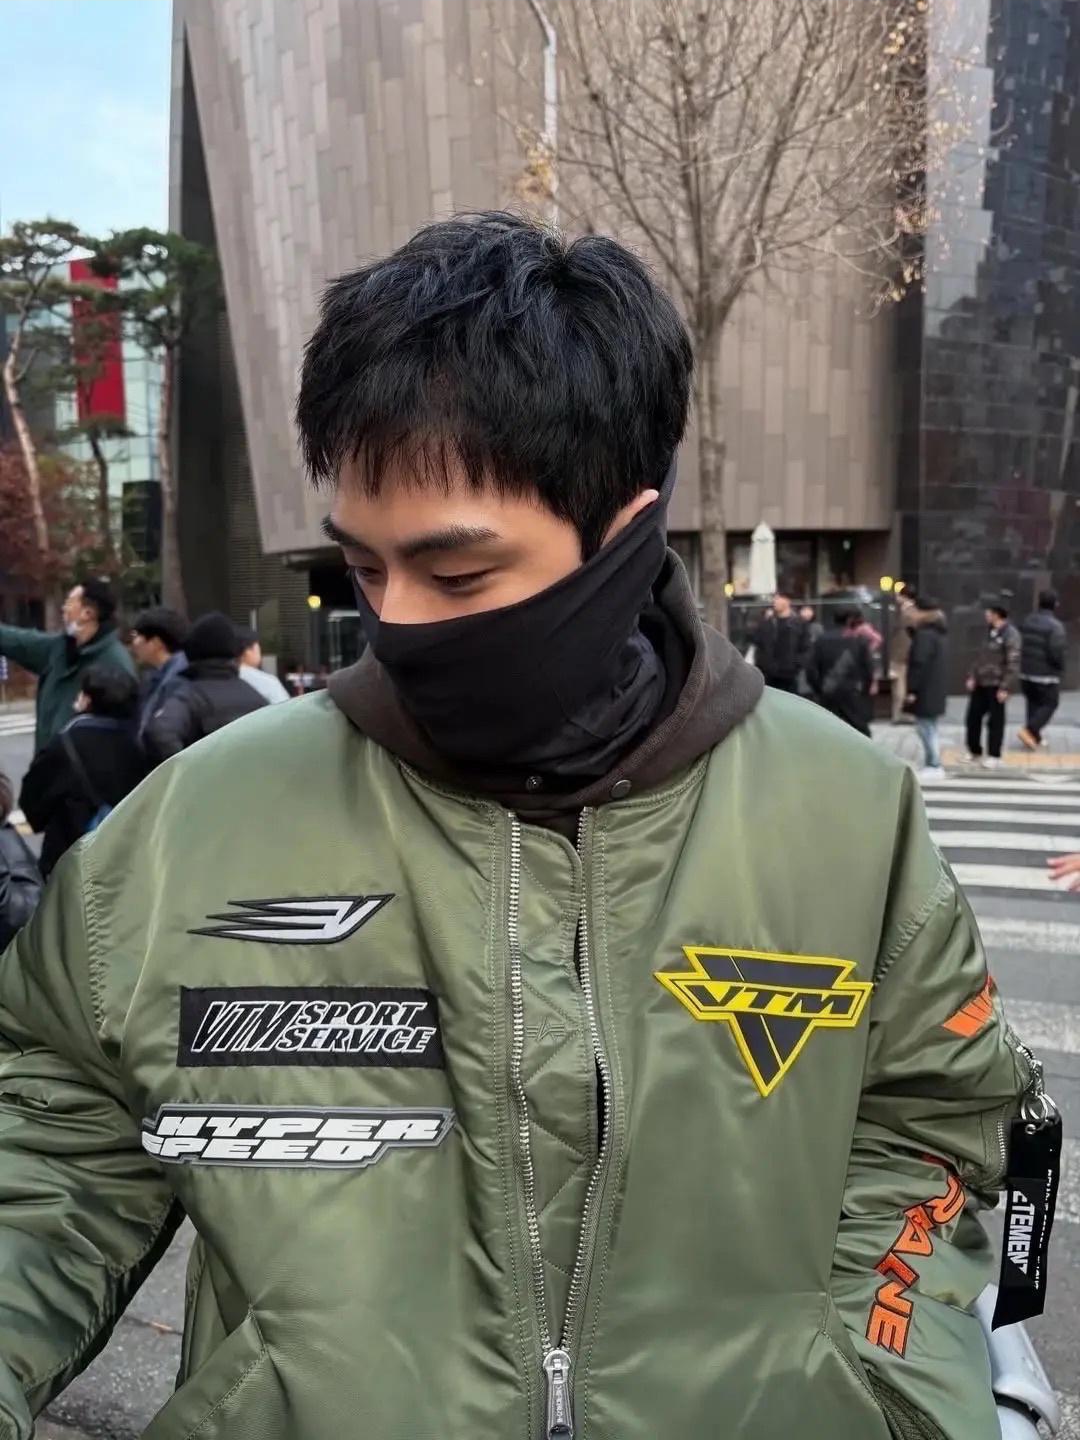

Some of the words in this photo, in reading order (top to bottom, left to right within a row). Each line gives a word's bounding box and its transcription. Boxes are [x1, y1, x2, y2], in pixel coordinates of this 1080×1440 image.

[684, 984, 856, 1015] VTM
[191, 1000, 307, 1053] VTM
[298, 1001, 428, 1027] SPORT
[276, 1026, 437, 1053] SERVICE
[156, 1116, 442, 1140] HYPER
[141, 1131, 383, 1161] SPEED
